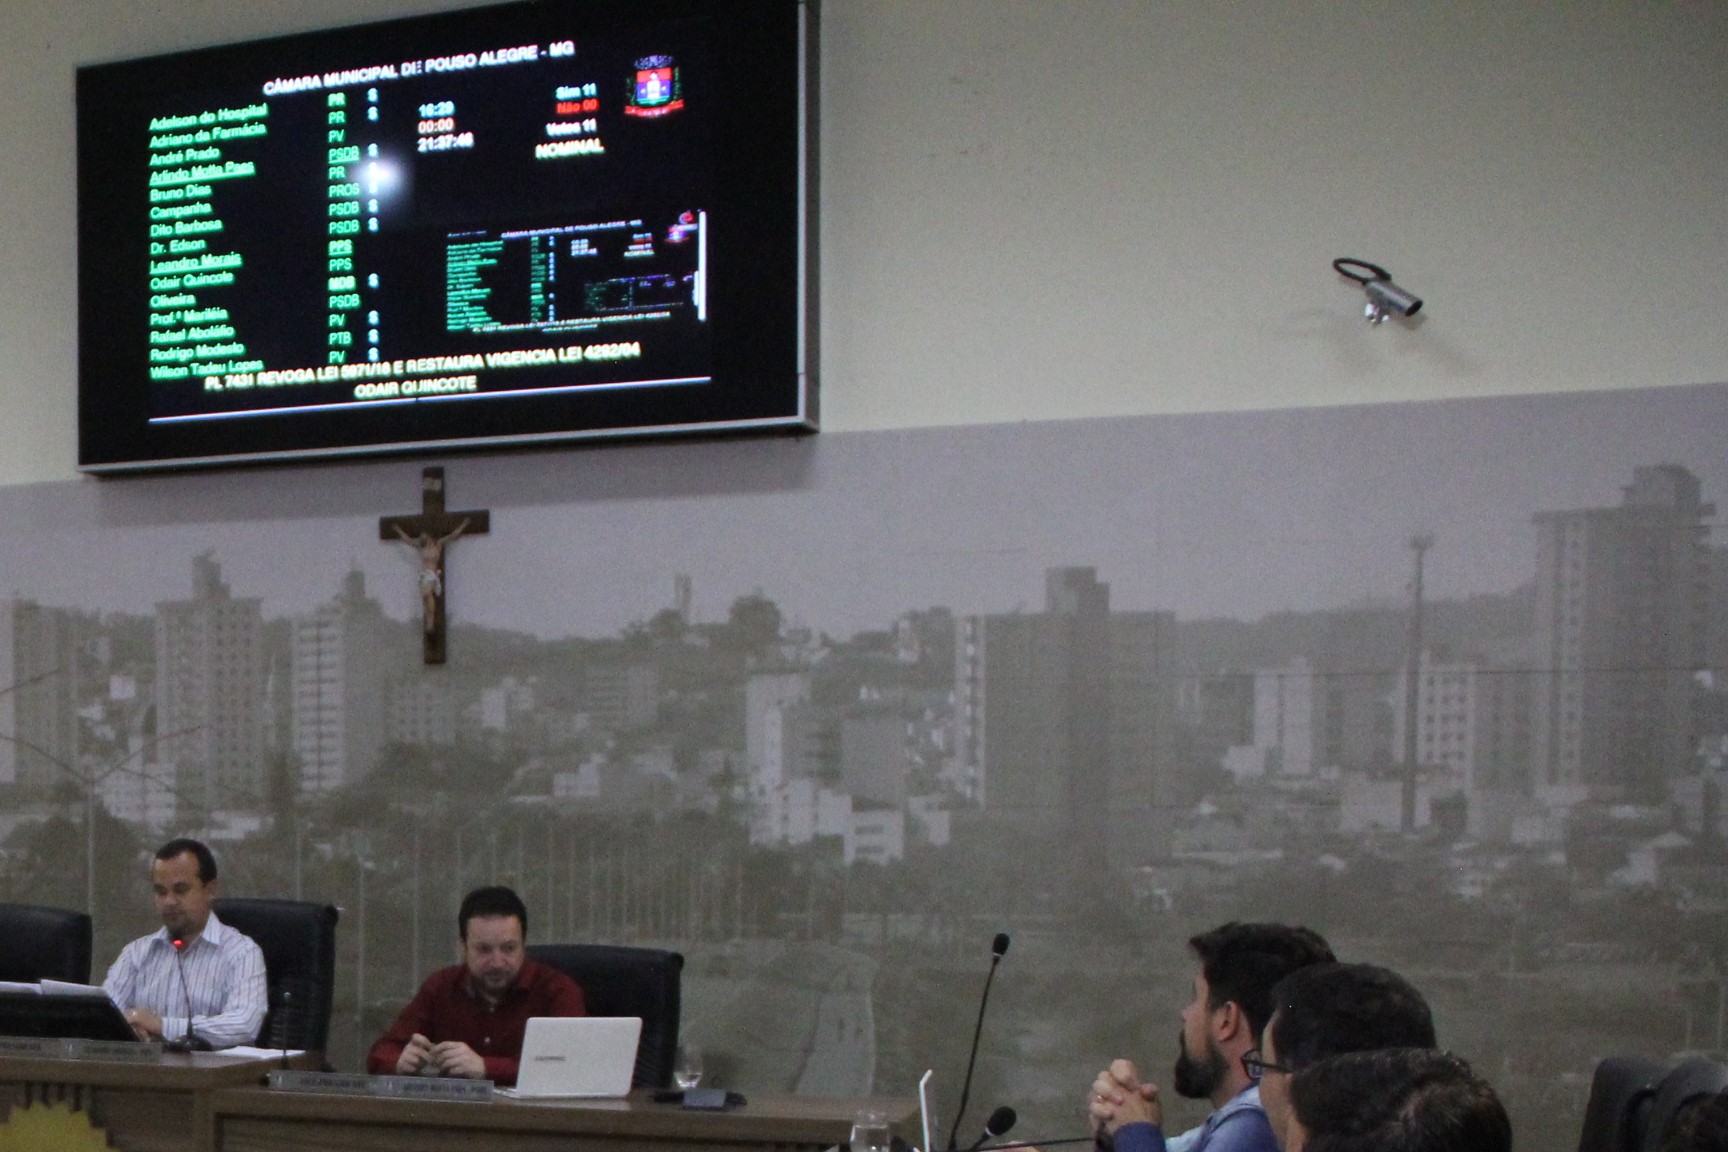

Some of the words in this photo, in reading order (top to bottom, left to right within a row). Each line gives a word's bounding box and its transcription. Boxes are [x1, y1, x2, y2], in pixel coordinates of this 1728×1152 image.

[263, 76, 322, 96] CÂMARA
[323, 64, 398, 87] MUNICIPAL
[425, 54, 477, 73] POUSO
[478, 45, 538, 66] ALEGRE
[549, 40, 575, 57] MG
[328, 92, 346, 107] PR
[367, 88, 378, 102] S
[556, 85, 581, 101] Sim
[582, 83, 597, 98] 11
[367, 106, 378, 121] S
[557, 100, 581, 114] Não
[583, 98, 599, 112] 00
[150, 116, 197, 131] Adelson
[199, 111, 216, 124] do
[218, 102, 268, 121] Hospital
[328, 110, 345, 124] PR
[418, 118, 455, 133] 00:00
[582, 118, 597, 132] 11
[150, 134, 193, 148] Adriano
[194, 129, 211, 142] da
[212, 122, 267, 139] Farmácia
[329, 129, 344, 143] PV
[328, 145, 360, 161] PSDB
[367, 143, 378, 157] S
[535, 137, 605, 159] NOMINAL
[150, 150, 184, 166] André
[185, 146, 221, 160] Prado
[150, 168, 190, 183] Arlindo
[329, 166, 345, 180] PR
[150, 188, 184, 202] Bruno
[185, 184, 212, 198] Dias
[329, 183, 360, 197] PROS
[150, 201, 212, 219] Campanha
[329, 201, 360, 216] PSDB
[368, 199, 378, 213] S
[150, 224, 173, 237] Dito
[174, 219, 223, 235] Barbosa
[329, 219, 360, 234] PSDB
[368, 217, 379, 232] S
[169, 239, 207, 253] Edson
[328, 239, 353, 254] PPS
[150, 257, 199, 273] Leandro
[200, 251, 243, 267] Morais
[329, 257, 352, 272] PPS
[150, 276, 181, 290] Odair
[183, 271, 235, 288] Quincote
[368, 273, 379, 288] S
[150, 293, 196, 308] Oliveira
[329, 293, 360, 308] PSDB
[329, 313, 345, 327] PV
[368, 310, 379, 325] S
[150, 329, 186, 344] Rafael
[329, 331, 352, 345] PTB
[368, 329, 379, 344] S
[150, 346, 194, 362] Rodrigo
[195, 341, 246, 358] Modesto
[329, 350, 345, 364] PV
[368, 347, 379, 362] S
[150, 366, 189, 379] Wilson
[190, 361, 227, 376] Tadeu
[228, 359, 264, 374] Lopes
[204, 376, 223, 391] PL
[224, 373, 254, 389] 7431
[256, 367, 315, 387] REVOGA
[317, 366, 338, 381] LEI
[393, 361, 403, 375] E
[406, 354, 484, 373] RESTAURA
[486, 348, 557, 368] VIGENCIA
[558, 346, 582, 363] LEI
[354, 380, 400, 399] ODAIR
